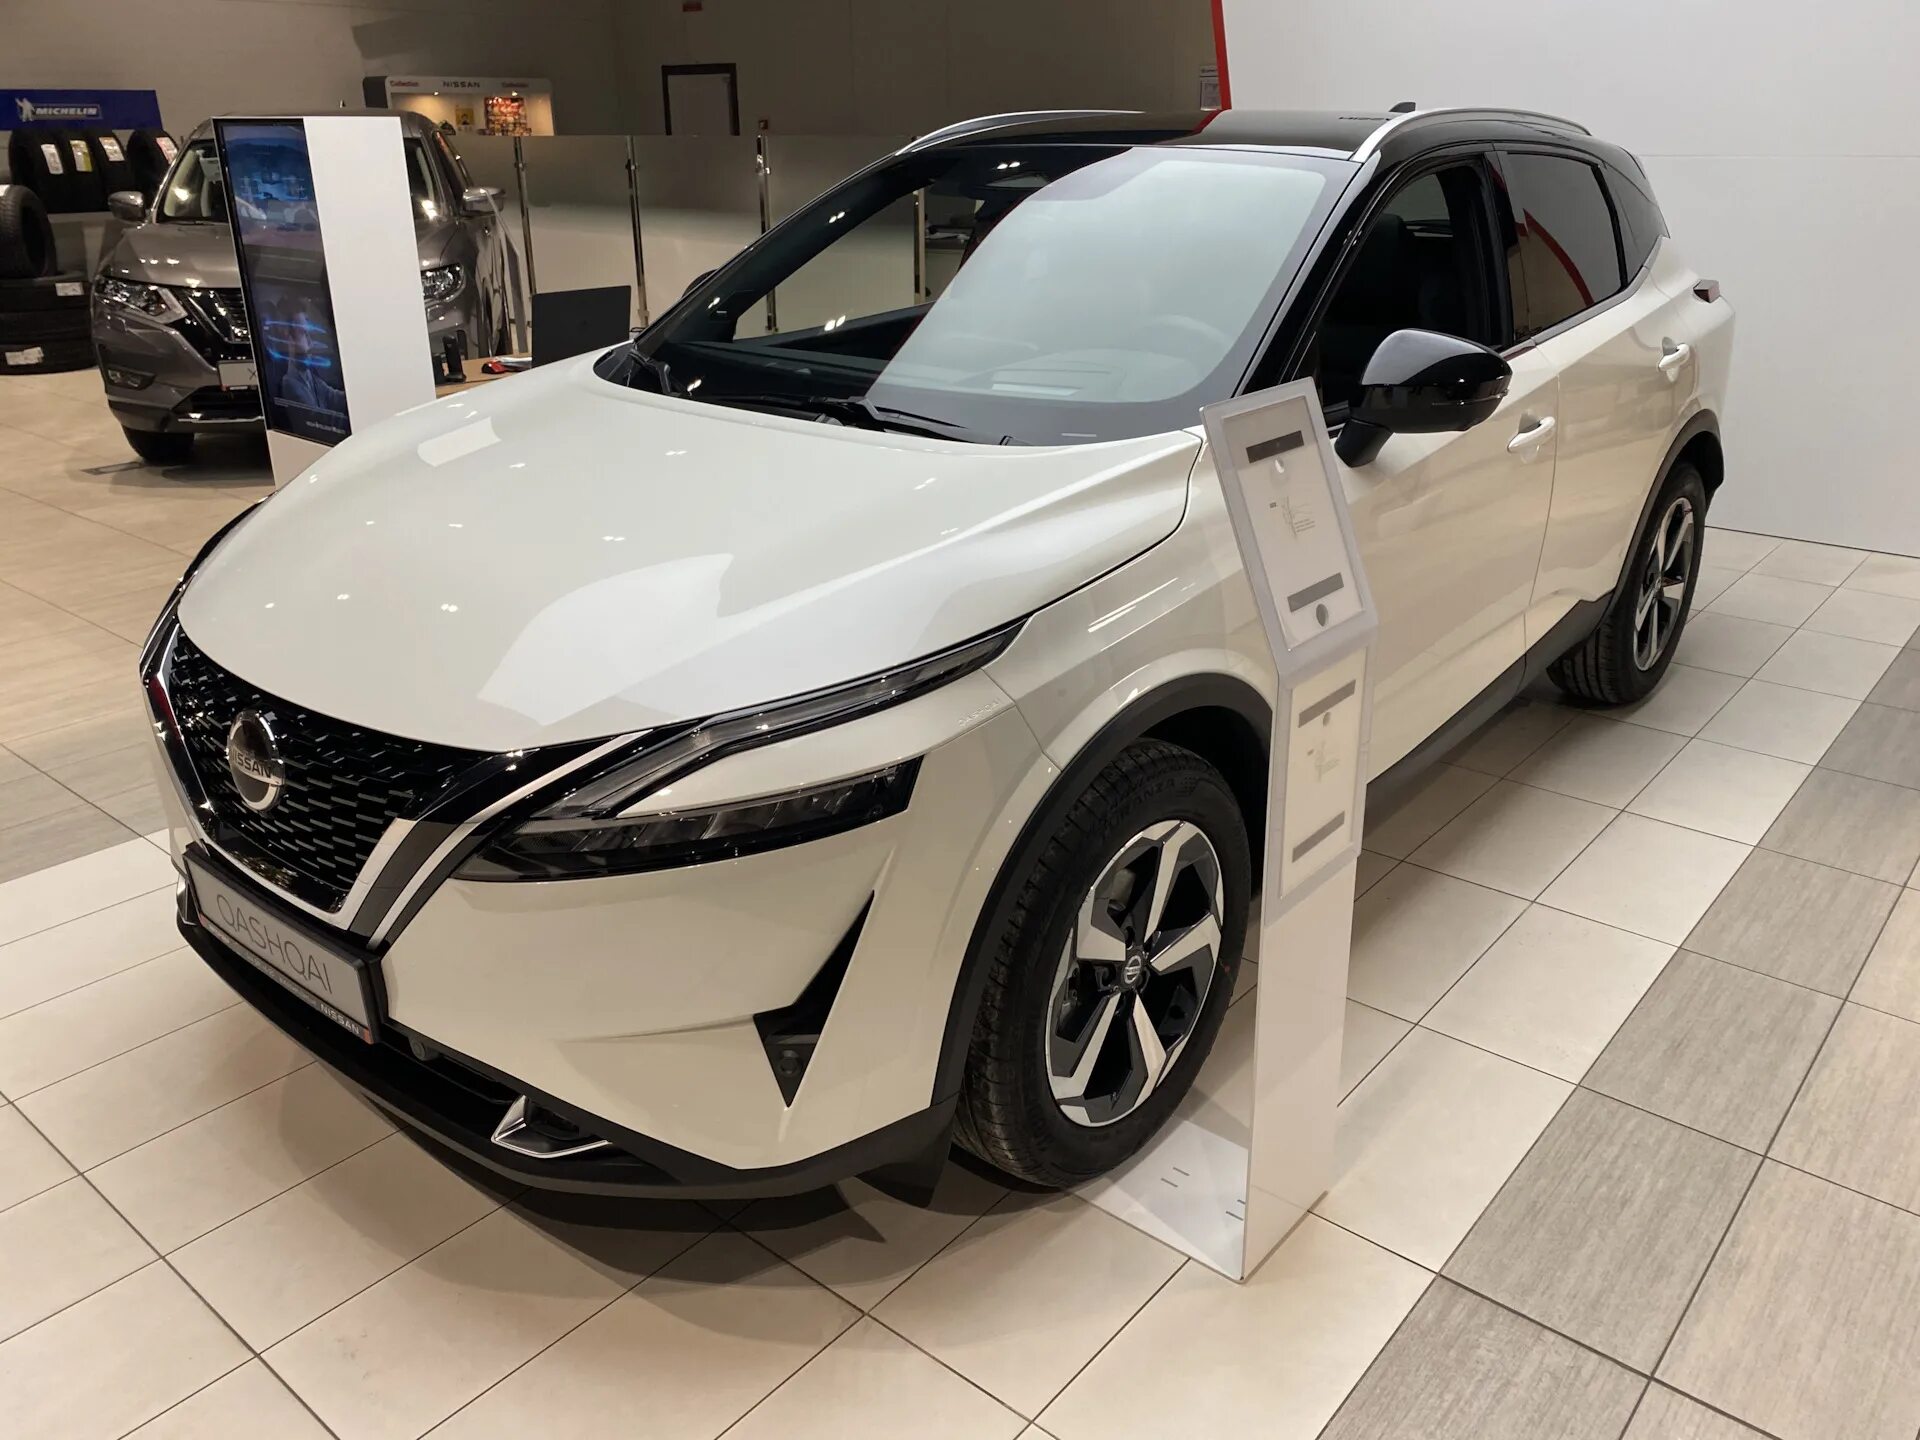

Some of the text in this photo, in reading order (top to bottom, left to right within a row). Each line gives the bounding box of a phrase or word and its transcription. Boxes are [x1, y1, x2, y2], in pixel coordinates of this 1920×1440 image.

[442, 80, 481, 88] NISSAN
[35, 107, 98, 116] MICHELIN
[217, 894, 333, 995] QASHQAI
[320, 1002, 360, 1035] NISSAN
